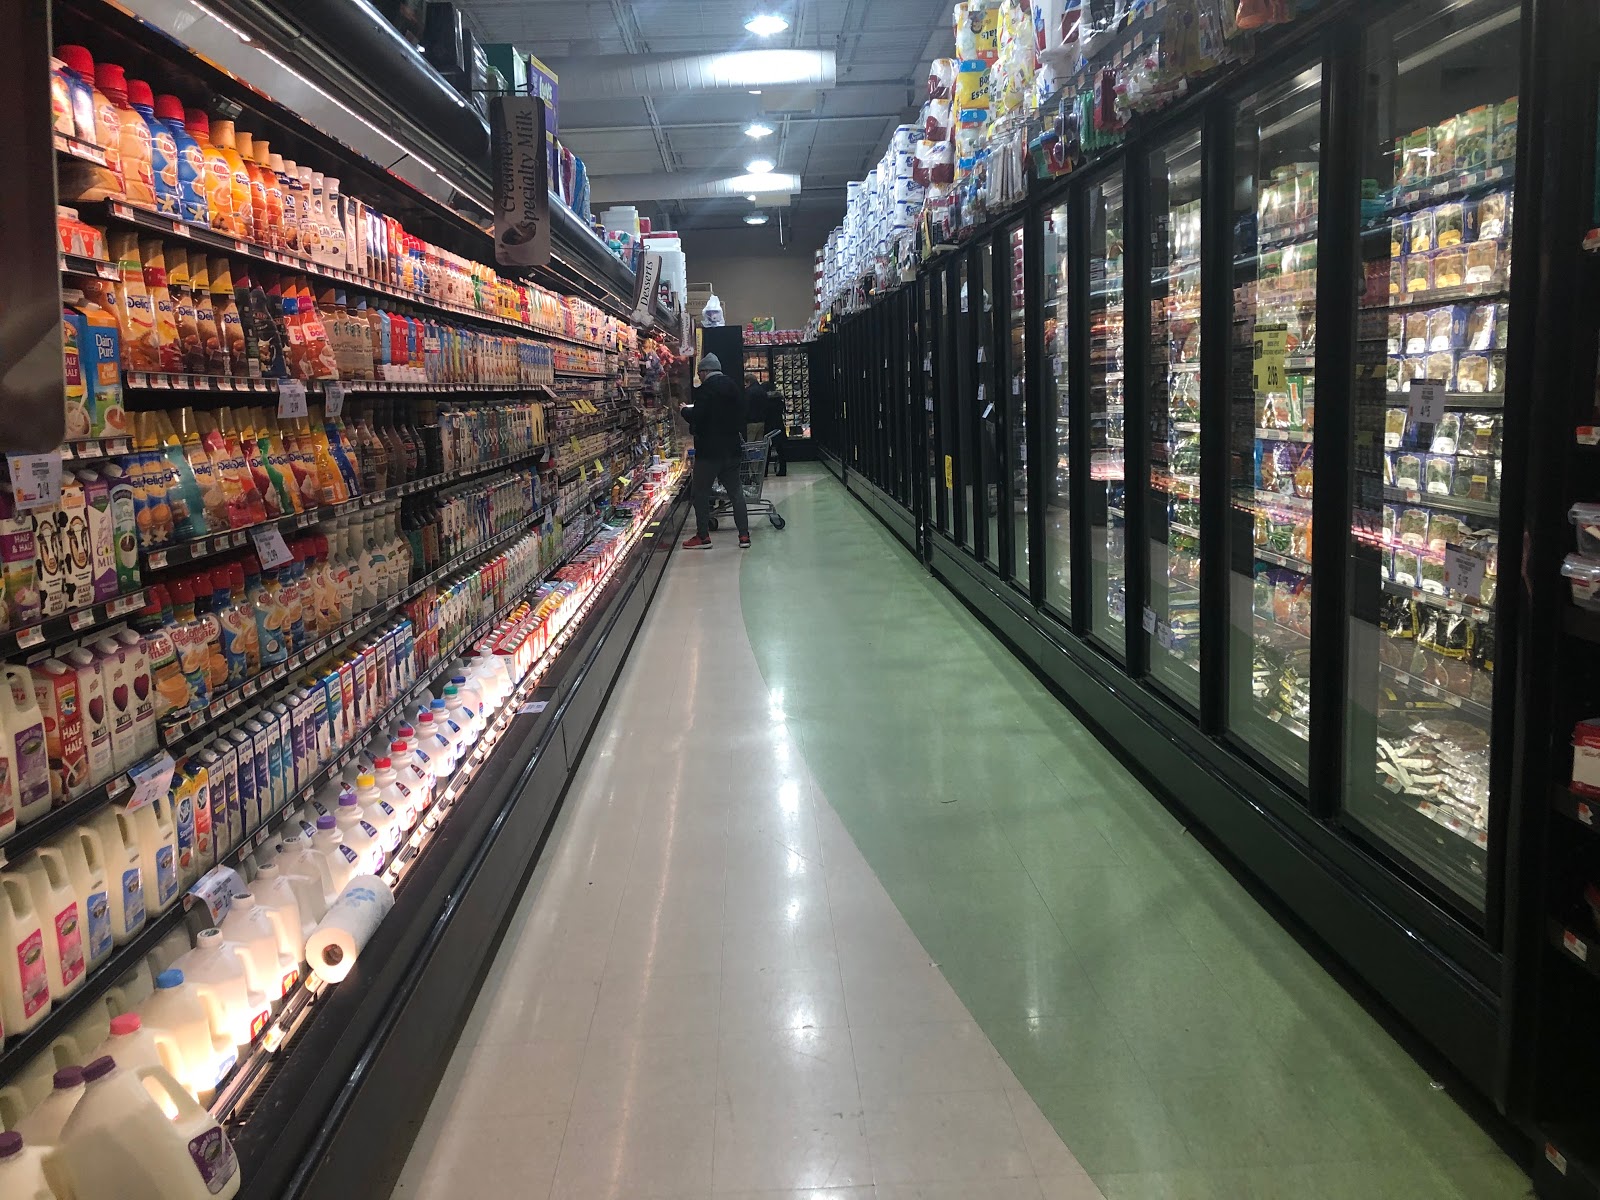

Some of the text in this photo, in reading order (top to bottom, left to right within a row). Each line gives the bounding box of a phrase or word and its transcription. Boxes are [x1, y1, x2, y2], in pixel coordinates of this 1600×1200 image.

[501, 131, 515, 212] Creamers
[516, 110, 539, 230] Specialty Milk
[640, 260, 654, 306] Desserts
[127, 296, 151, 312] Delig
[158, 300, 172, 312] Deli
[96, 334, 114, 348] Dairy
[98, 346, 114, 359] Pure
[66, 357, 77, 365] ALF
[14, 533, 31, 542] HALF
[19, 541, 33, 552] HALF
[62, 721, 81, 740] HALF
[64, 737, 83, 756] HALF
